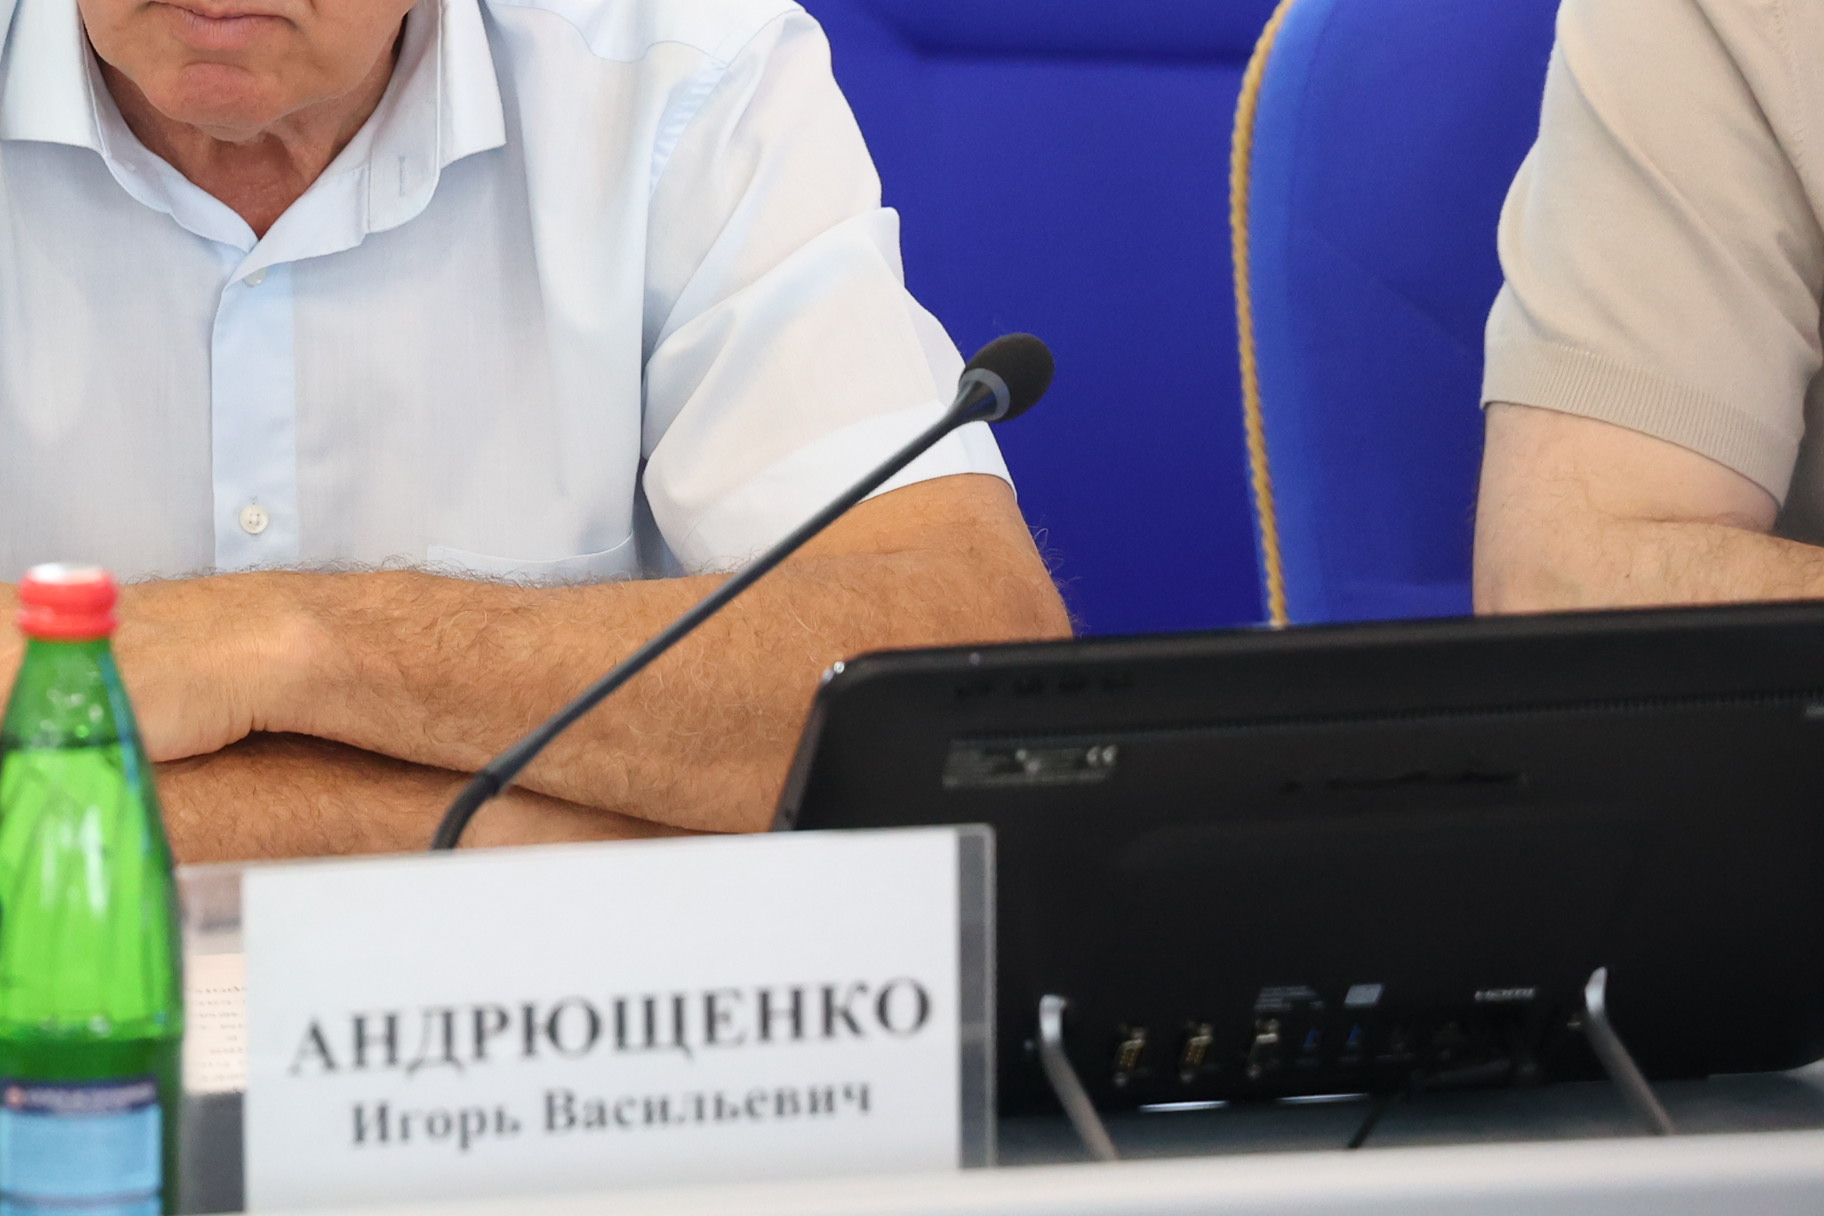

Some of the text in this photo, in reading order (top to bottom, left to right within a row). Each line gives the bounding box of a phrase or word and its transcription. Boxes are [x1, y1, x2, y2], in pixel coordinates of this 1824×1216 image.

[288, 978, 935, 1076] АНДРЮЩЕНКО
[349, 1083, 874, 1152] Игорь Васильевич
